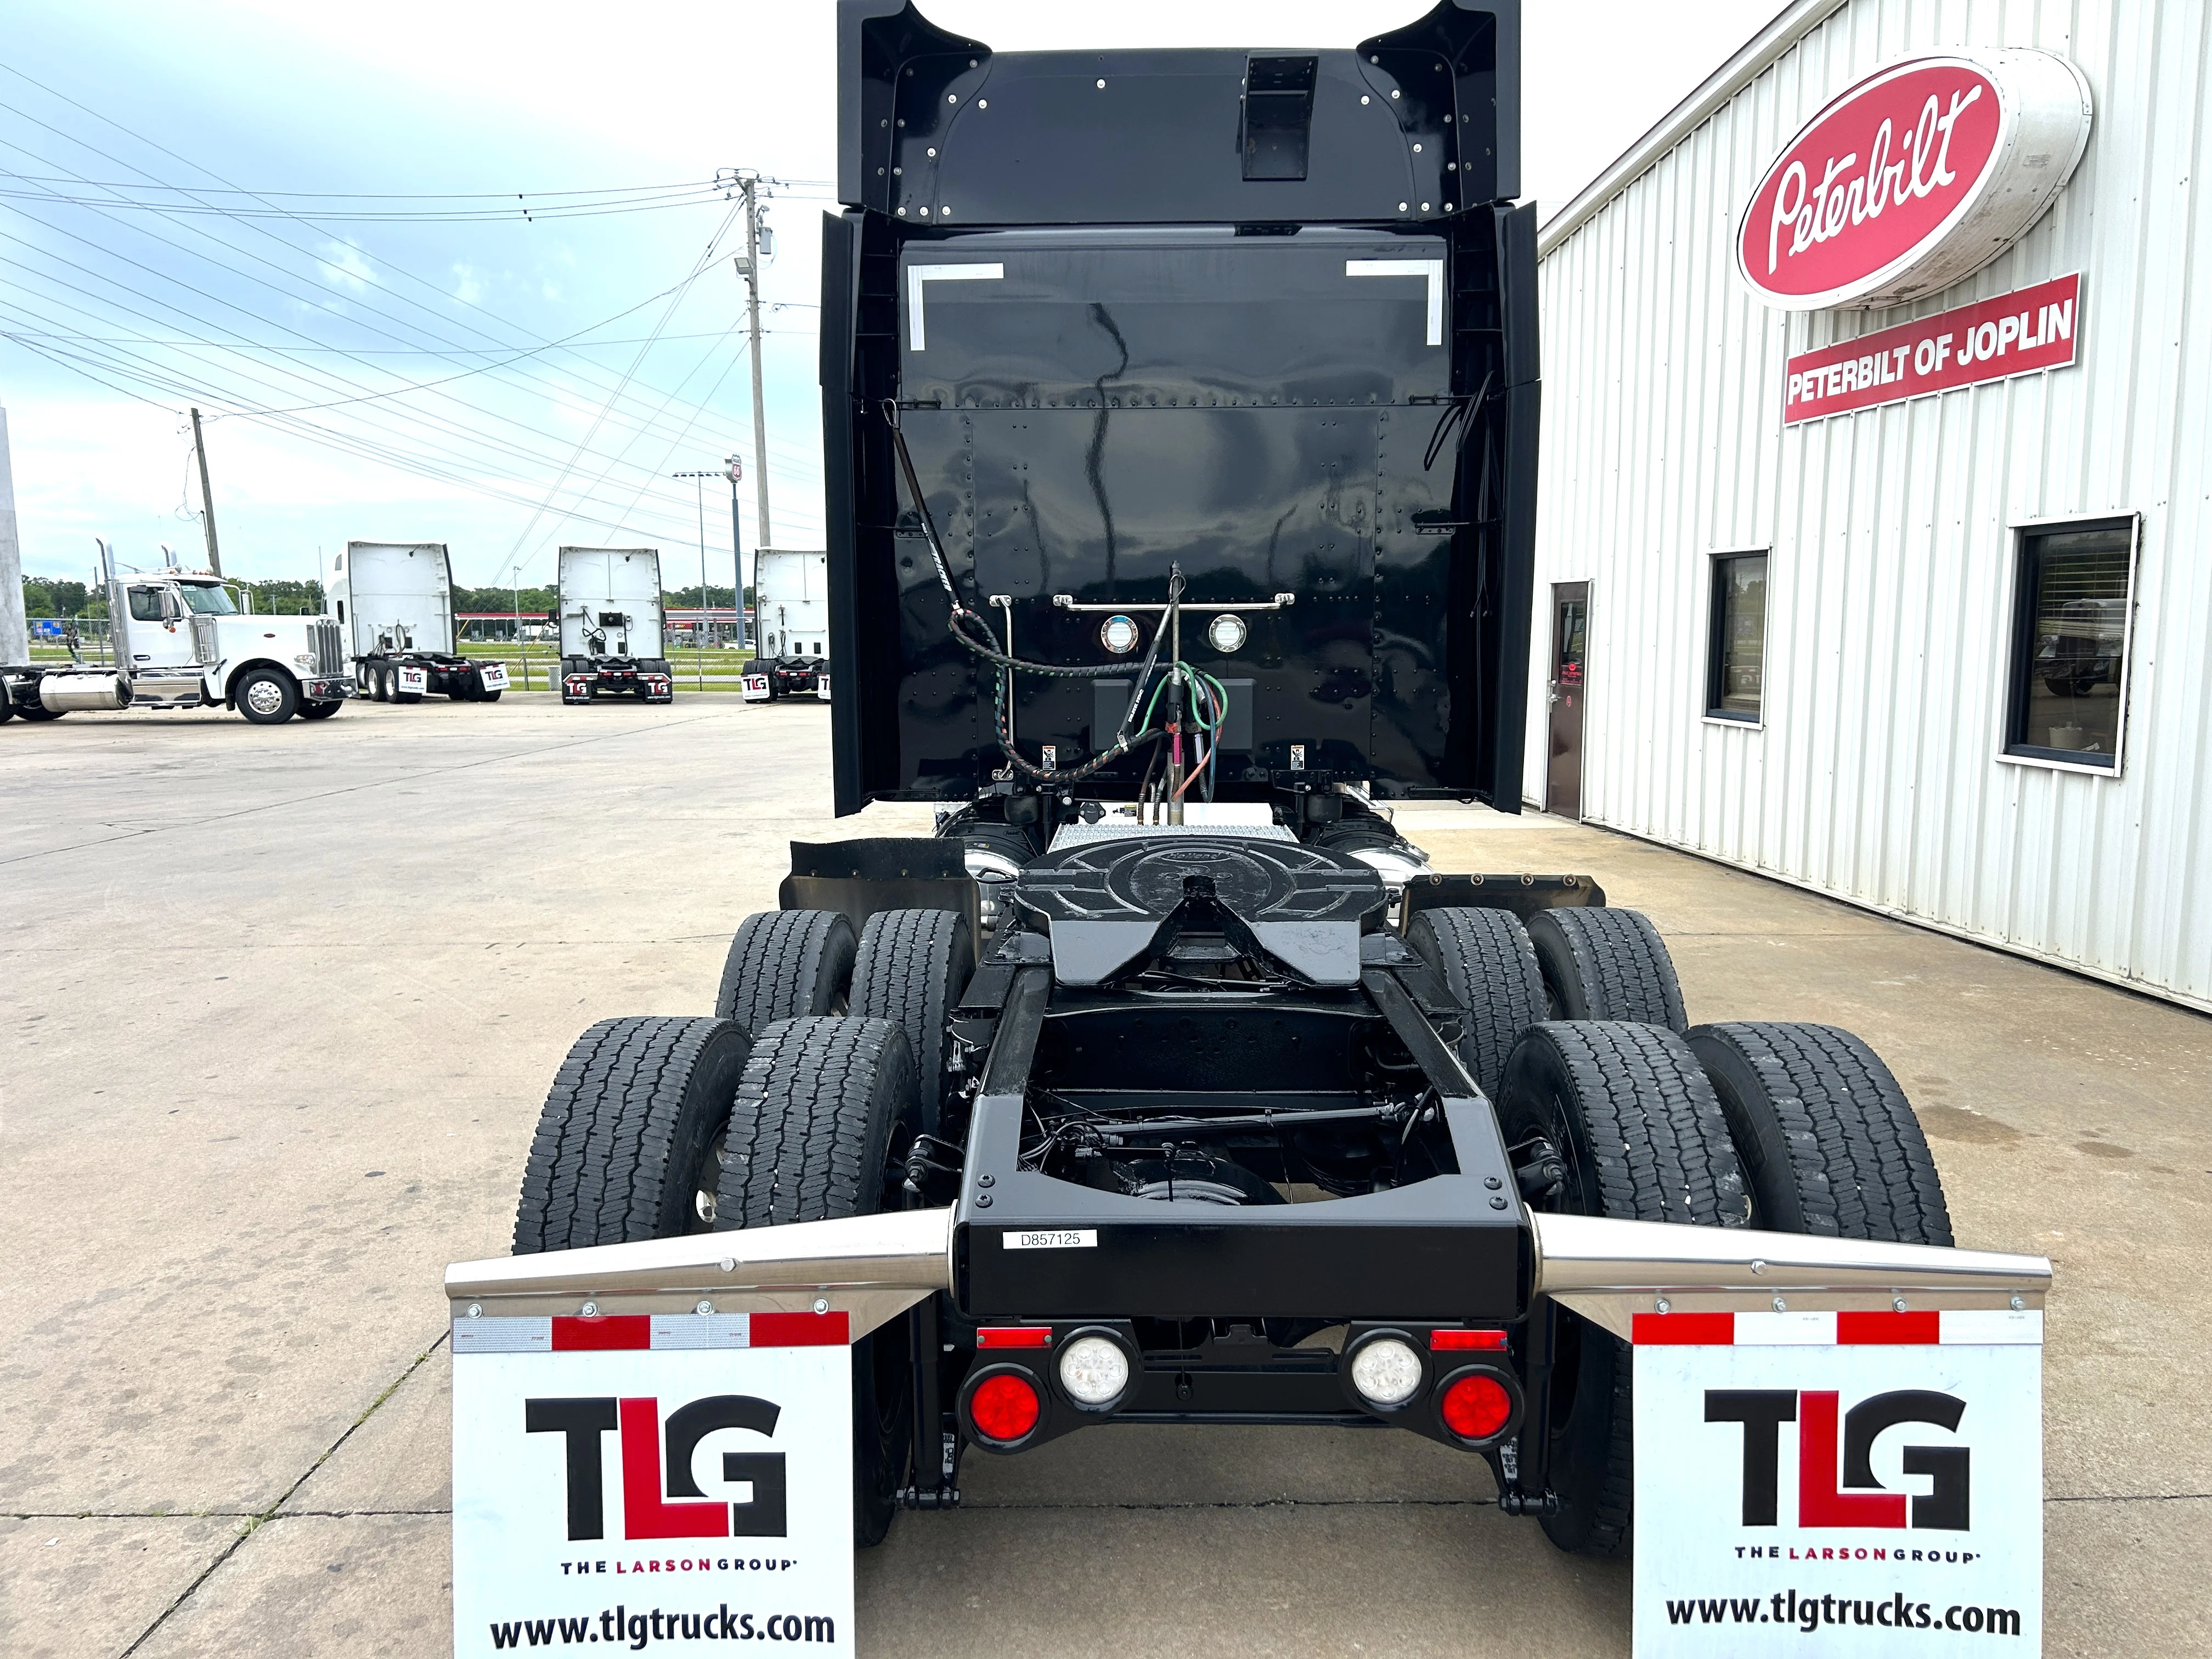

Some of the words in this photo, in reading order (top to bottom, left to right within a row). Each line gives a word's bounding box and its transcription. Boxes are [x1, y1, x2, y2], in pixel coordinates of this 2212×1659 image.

[1769, 84, 1982, 274] Peterbilt
[1787, 346, 1910, 405] PETERBILT
[1914, 334, 1954, 375] OF
[1957, 299, 2073, 366] JOPLIN
[403, 672, 421, 682] TLG
[485, 670, 503, 681] TLG
[567, 682, 586, 693] TLG
[648, 682, 668, 693] TLG
[743, 678, 767, 691] TLG
[1022, 1233, 1080, 1246] D857125
[526, 1395, 787, 1541] TLG
[1704, 1389, 1971, 1531] TLG
[1735, 1546, 1780, 1559] THE
[1789, 1547, 1886, 1560] LARSON
[1893, 1549, 1974, 1564] GROUP
[561, 1561, 606, 1575] THE
[617, 1559, 710, 1573] LARSON
[717, 1559, 791, 1571] GROUP
[1665, 1589, 2021, 1636] www.tlgtrucks.com
[490, 1604, 835, 1650] www.tlgtrucks.com
